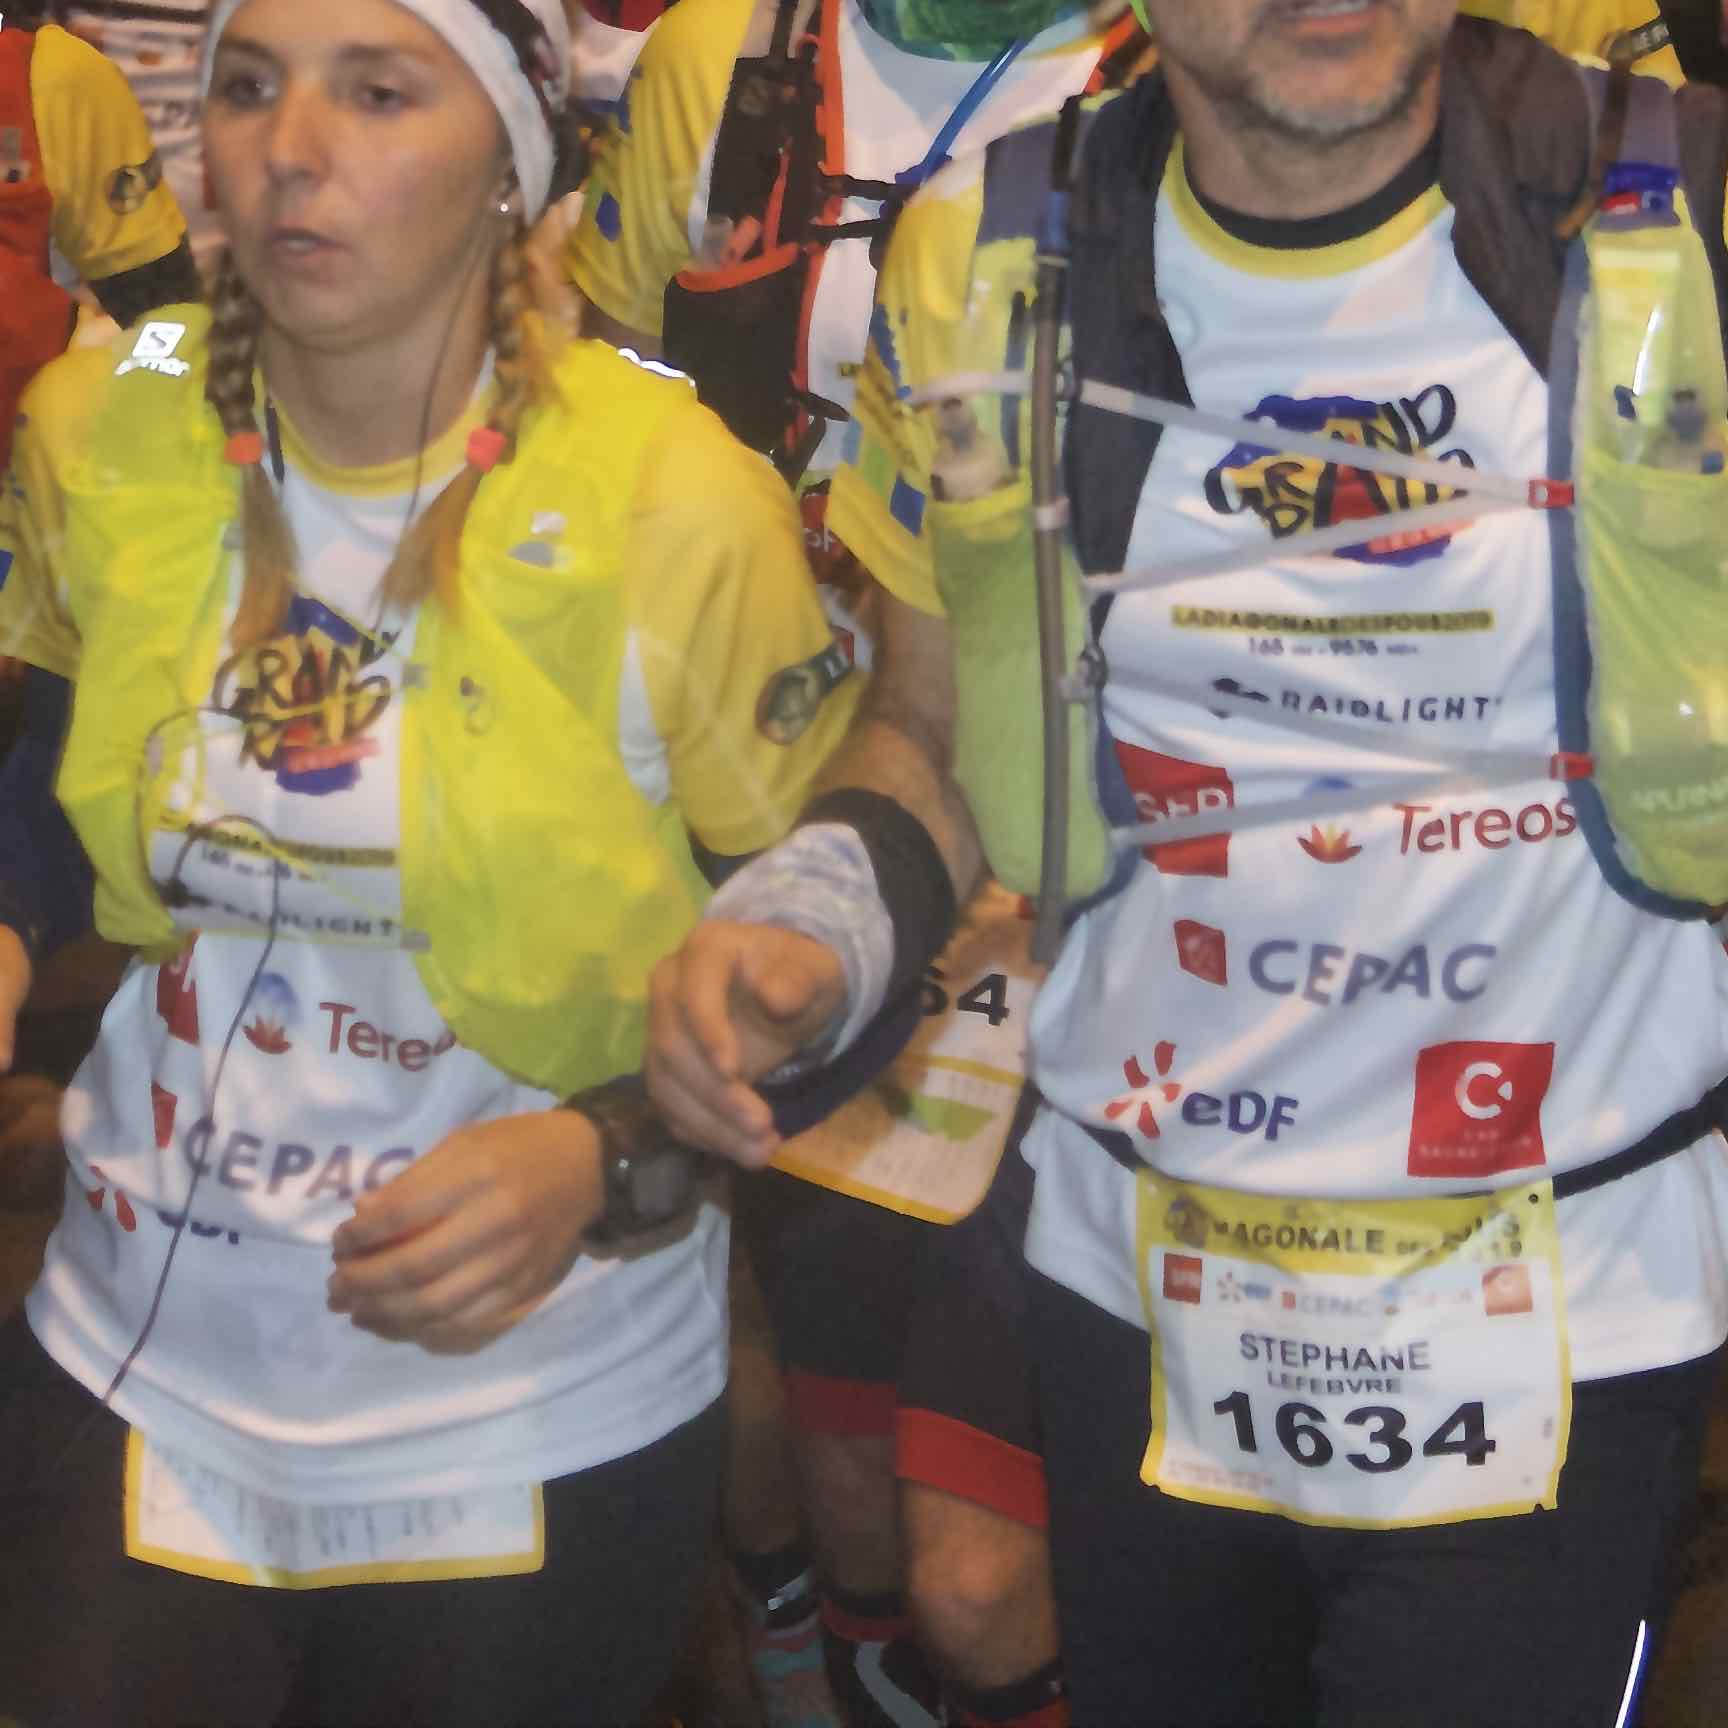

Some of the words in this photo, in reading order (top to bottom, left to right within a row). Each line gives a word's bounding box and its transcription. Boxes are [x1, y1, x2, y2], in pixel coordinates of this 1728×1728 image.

[1281, 689, 1489, 723] RAIDLIGHT
[1393, 799, 1579, 855] Tereos
[1248, 939, 1498, 1005] CEPAC
[1181, 1089, 1301, 1141] eDF
[1239, 1331, 1432, 1372] STEPHANE
[1266, 1373, 1402, 1394] LEFEBVRE
[1213, 1391, 1497, 1473] 1634
